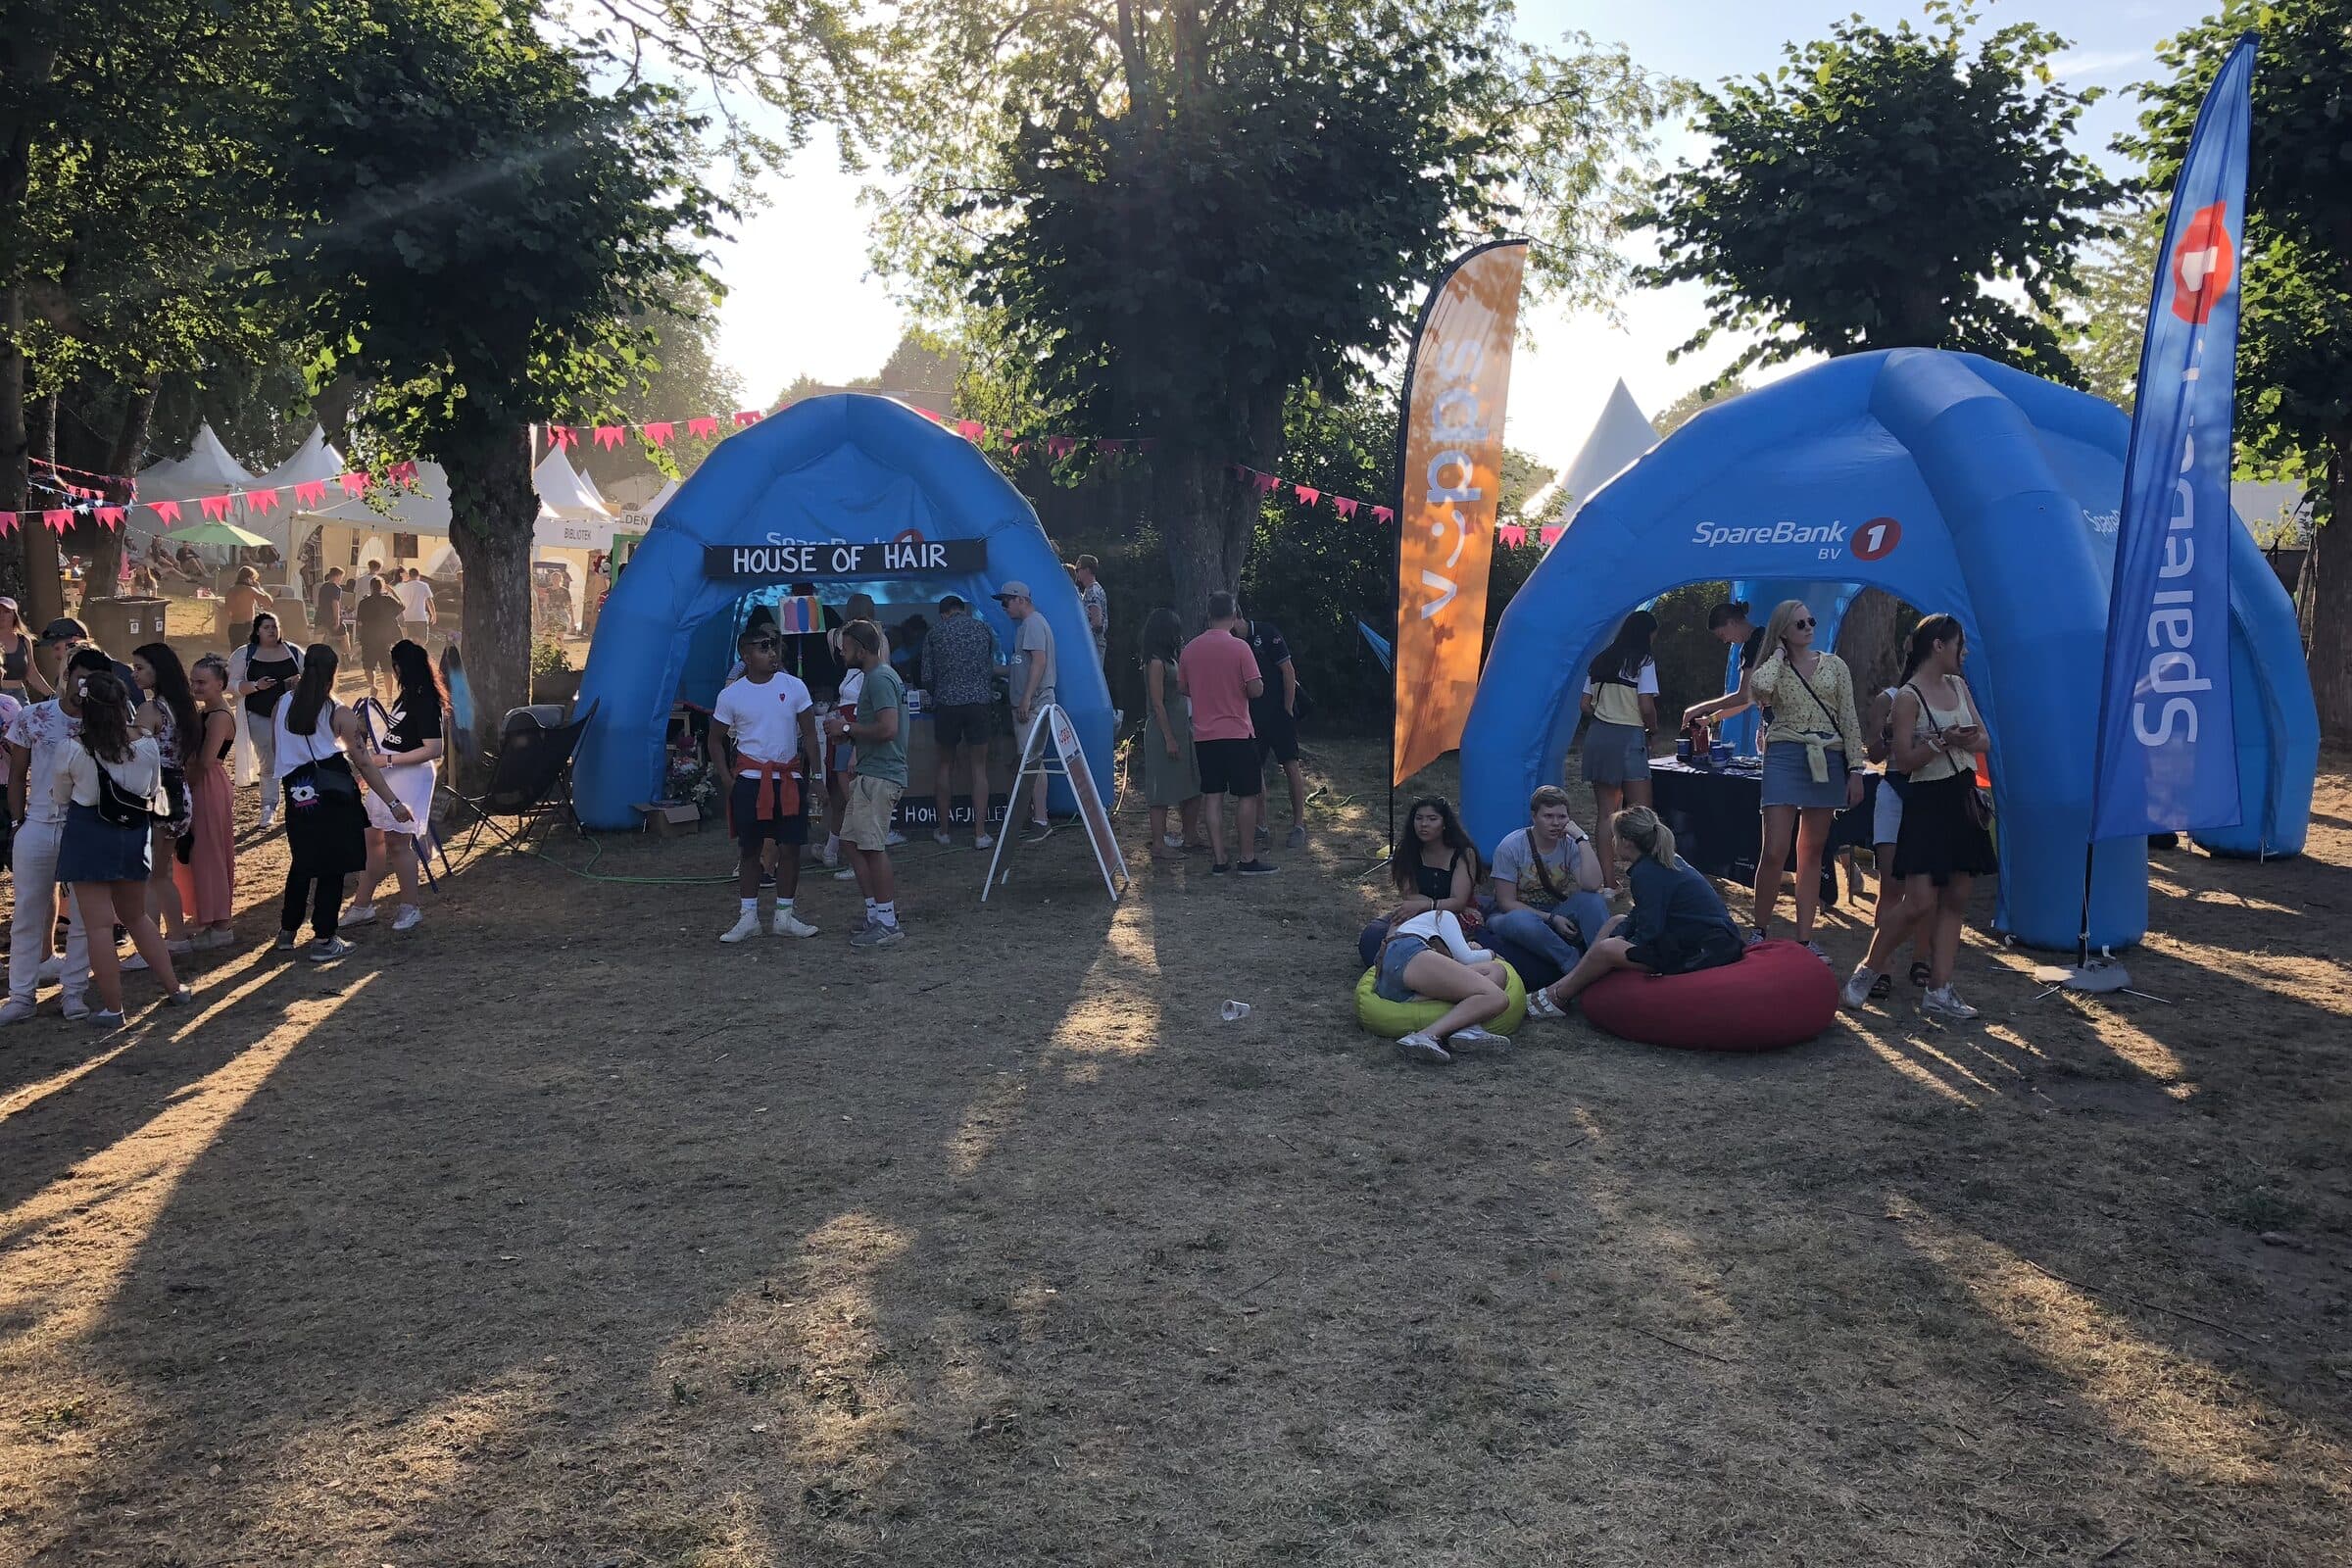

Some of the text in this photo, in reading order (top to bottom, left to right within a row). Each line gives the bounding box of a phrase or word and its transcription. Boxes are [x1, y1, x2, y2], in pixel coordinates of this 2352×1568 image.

[564, 527, 592, 540] BIBLIOTEK
[1692, 520, 1886, 553] SpareBank 1
[733, 543, 948, 573] HOUSE OF HAIR
[1818, 548, 1841, 560] BV
